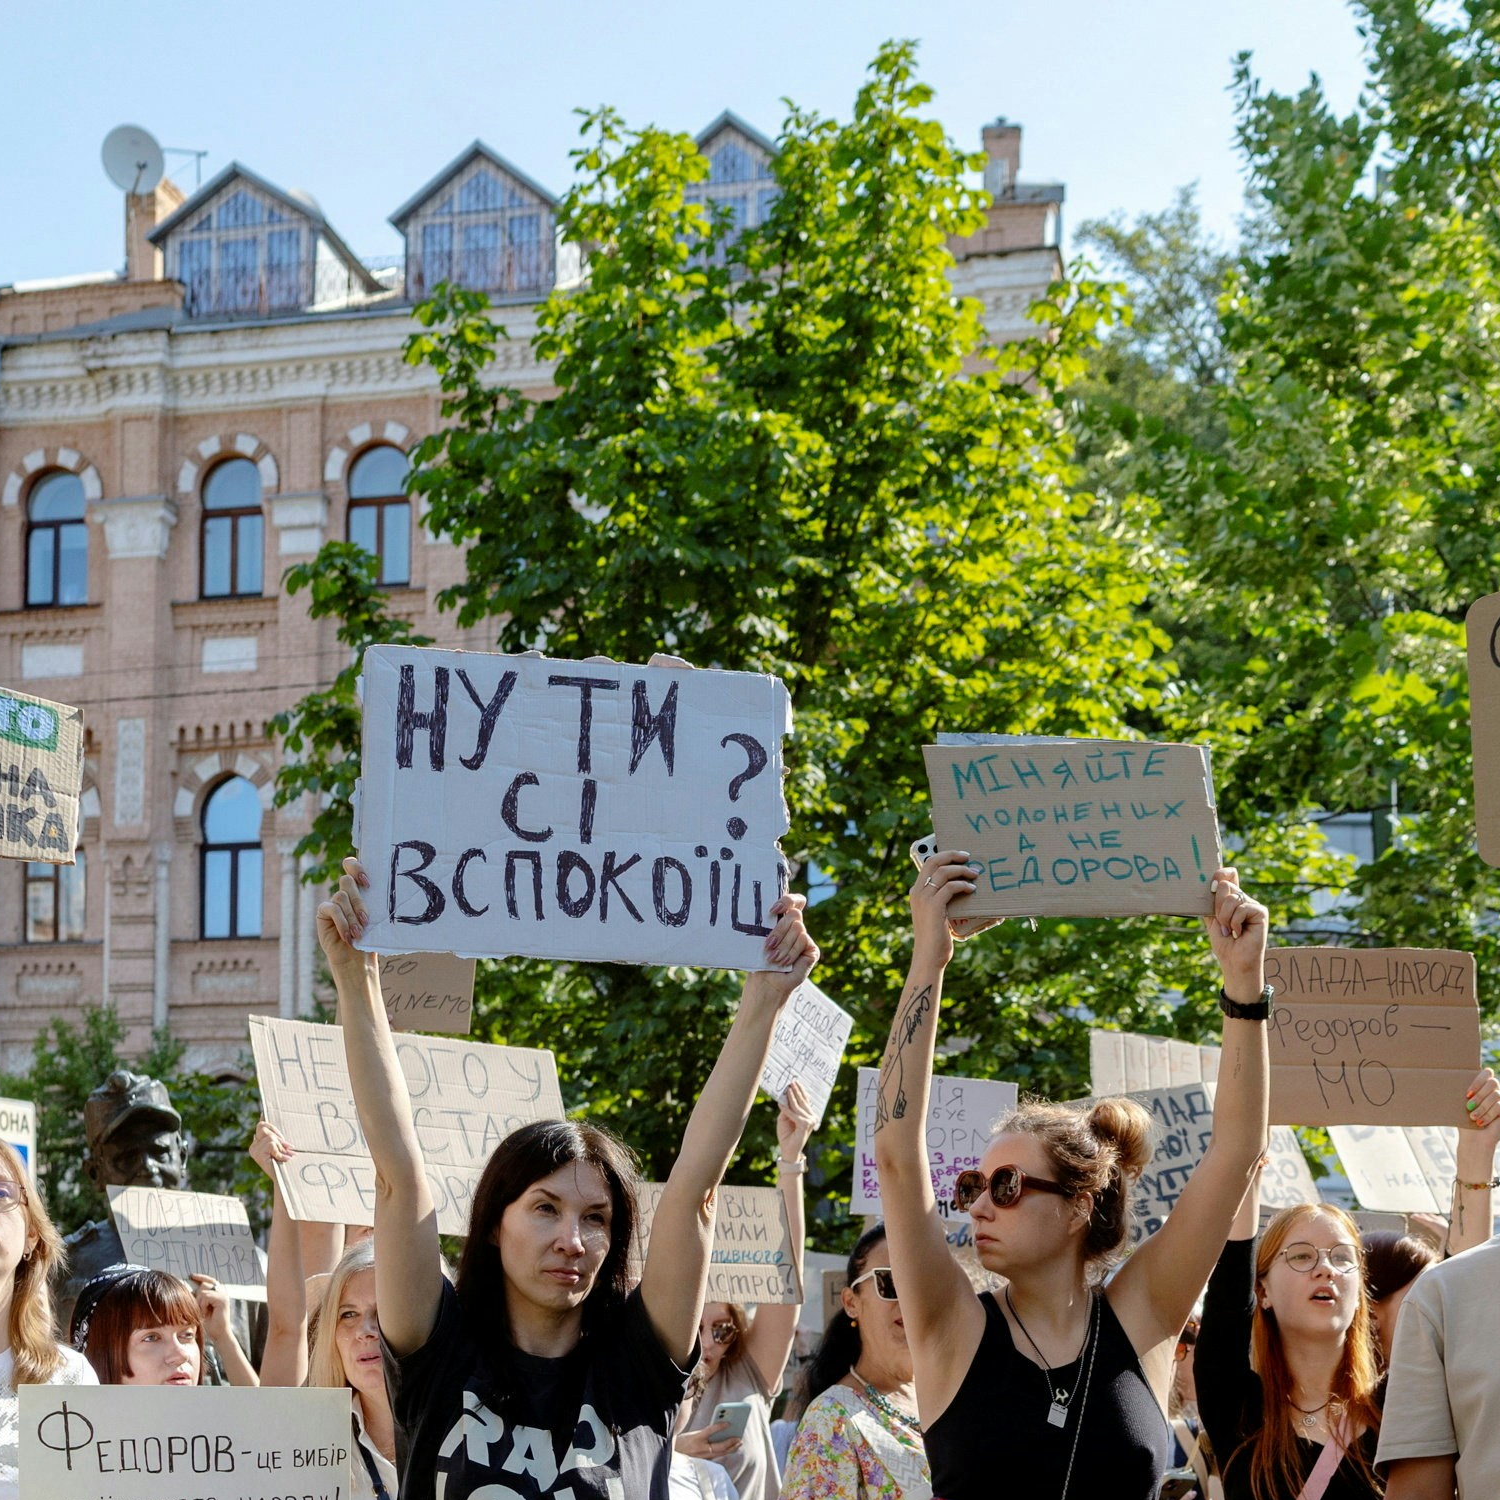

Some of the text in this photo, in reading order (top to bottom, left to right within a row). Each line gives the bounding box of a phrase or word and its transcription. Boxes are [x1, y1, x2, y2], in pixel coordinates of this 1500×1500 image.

[396, 664, 679, 777] НУ ТИ
[951, 747, 1170, 800] МІНЯЙТЕ
[501, 771, 597, 844] СІ
[965, 800, 1185, 834] ПОЛОНЕНИХ
[1018, 829, 1123, 854] А НЕ
[396, 1044, 489, 1099] ОГО
[506, 1054, 543, 1102] У
[1312, 1057, 1395, 1110] МО
[723, 1193, 764, 1219] ВИ
[292, 1442, 349, 1468] ВИБІР
